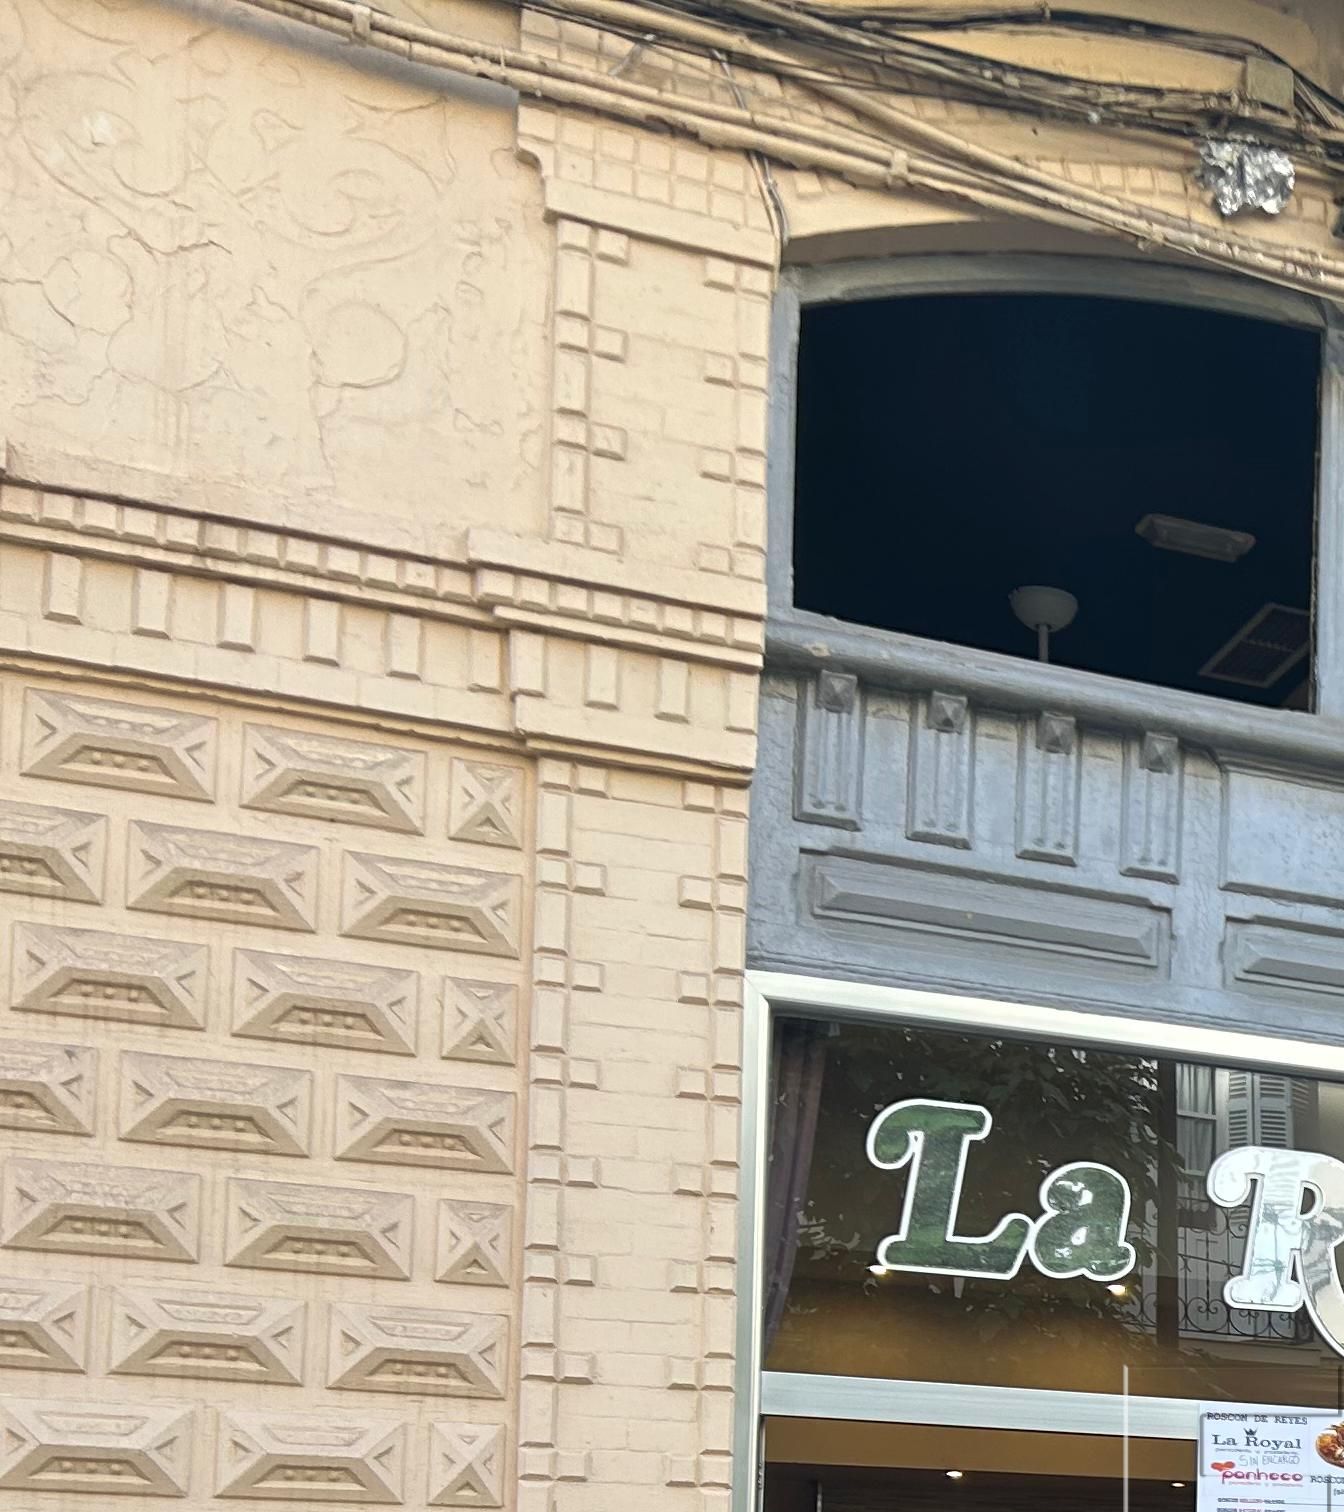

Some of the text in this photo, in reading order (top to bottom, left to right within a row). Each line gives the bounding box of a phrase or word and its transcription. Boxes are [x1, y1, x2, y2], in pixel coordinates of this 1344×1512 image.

[866, 1098, 1137, 1283] La
[1206, 1412, 1308, 1426] ROSCON DE REYES
[1211, 1434, 1238, 1446] La
[1245, 1435, 1302, 1451] Royal
[1238, 1454, 1259, 1468] SIN
